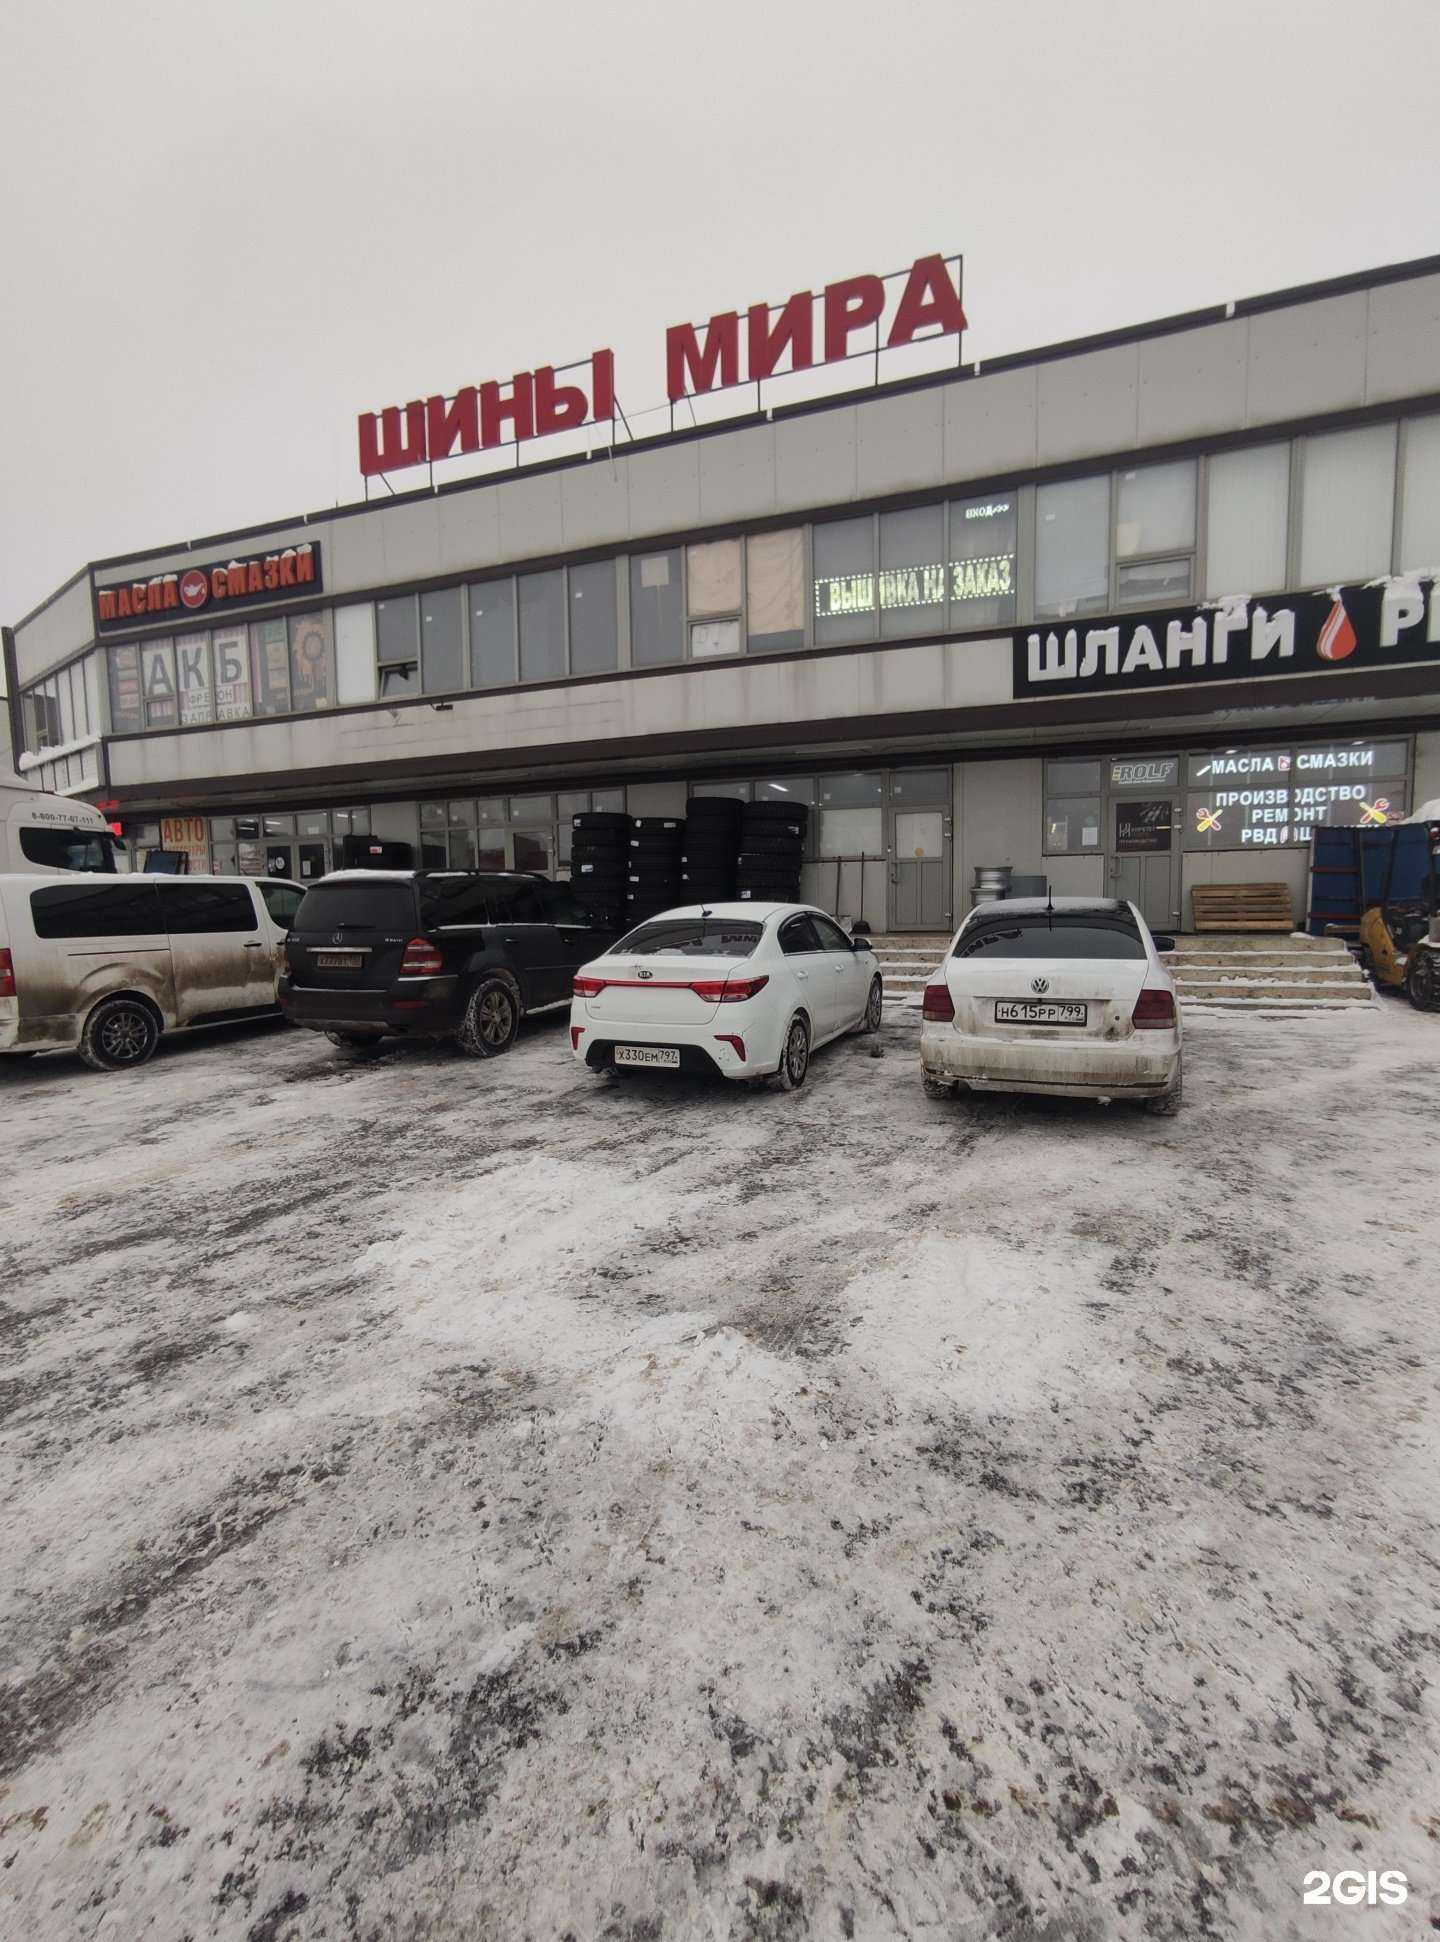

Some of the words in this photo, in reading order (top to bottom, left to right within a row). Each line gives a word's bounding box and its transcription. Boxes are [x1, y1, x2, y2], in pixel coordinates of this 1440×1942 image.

[358, 348, 615, 477] ШИНЫ
[666, 252, 969, 402] МИРА
[98, 574, 180, 620] МАСЛА
[211, 543, 314, 600] СМАЗКИ
[952, 560, 1012, 598] ЗАКАЗ
[1027, 606, 1296, 682] ШЛАНГИ
[1379, 583, 1440, 648] Р
[149, 640, 243, 698] АКБ
[1118, 762, 1174, 781] ROLF
[1211, 757, 1273, 775] МАСЛА
[1296, 750, 1373, 770] СМАЗКИ
[163, 815, 205, 843] АВТО
[1241, 828, 1277, 845] РВД
